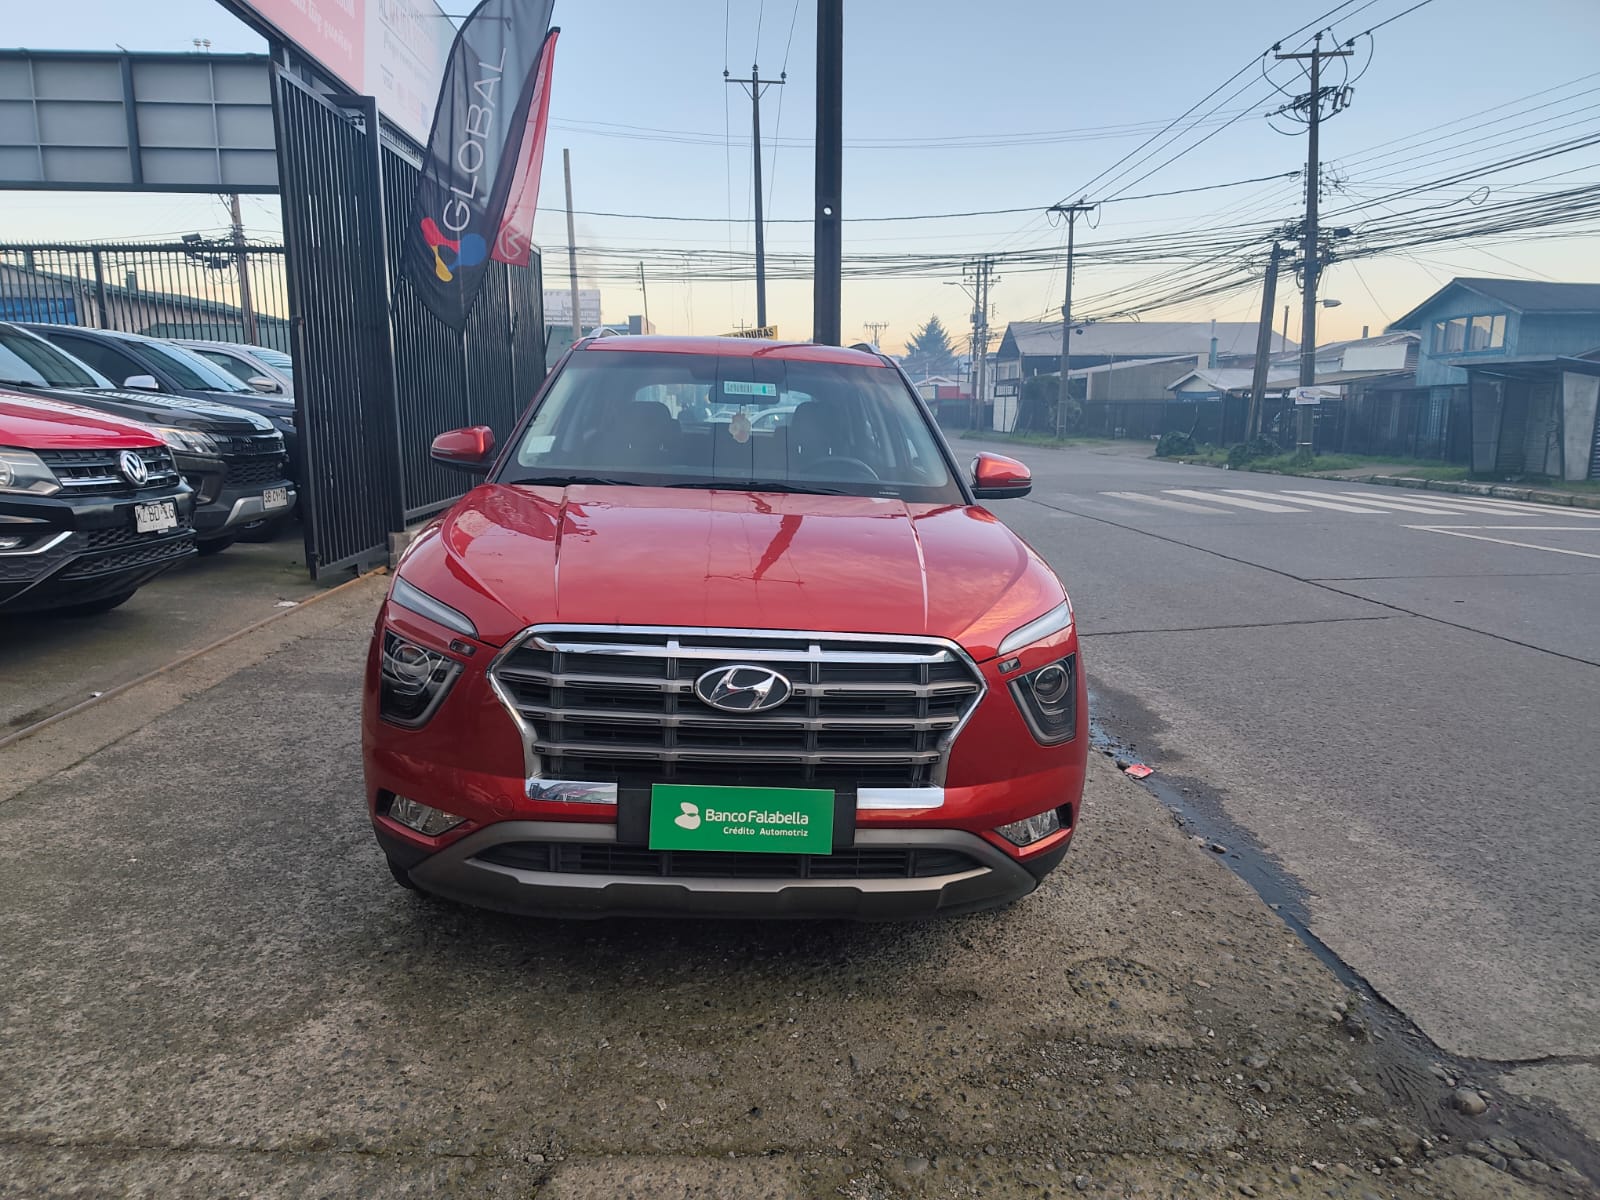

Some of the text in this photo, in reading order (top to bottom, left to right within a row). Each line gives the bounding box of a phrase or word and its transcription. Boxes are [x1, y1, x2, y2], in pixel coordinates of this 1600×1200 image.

[443, 48, 506, 232] GLOBAL
[723, 826, 808, 837] Crédito Automotriz
